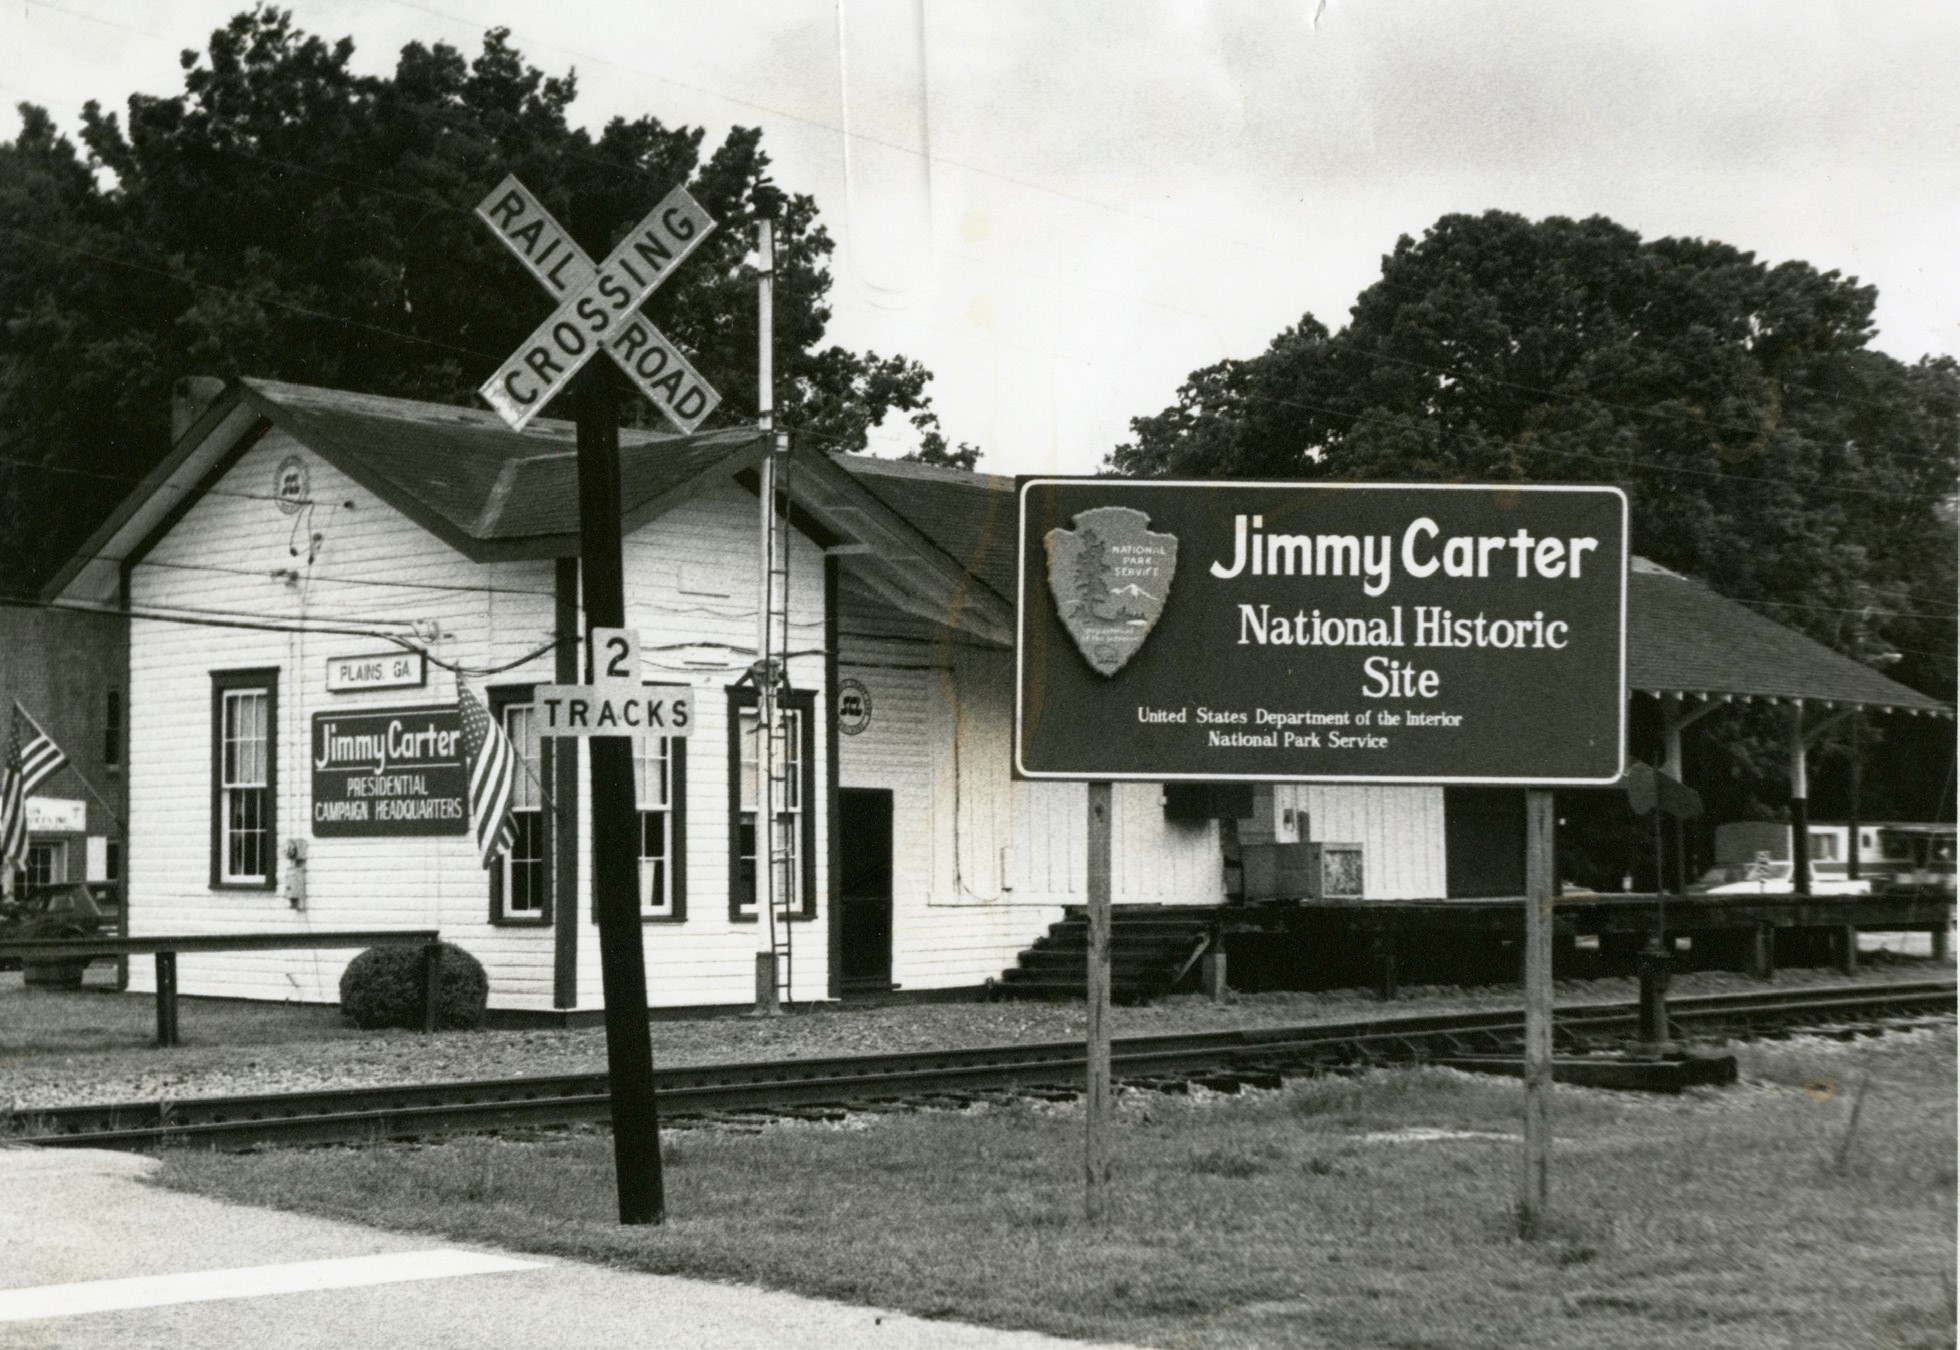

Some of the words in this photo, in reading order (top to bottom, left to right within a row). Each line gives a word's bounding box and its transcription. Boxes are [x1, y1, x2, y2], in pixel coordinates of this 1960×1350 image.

[489, 189, 574, 292] RAIL
[612, 321, 707, 420] ROAD
[504, 207, 695, 406] CROSSING
[1112, 545, 1166, 555] NATIONAL
[1123, 556, 1152, 565] PARK
[1209, 514, 1392, 597] Jimmy
[1401, 517, 1599, 579] Carter
[1114, 567, 1160, 577] SERVICE
[1237, 604, 1405, 647] National
[1413, 606, 1569, 649] Historic
[605, 636, 630, 678] 2
[1362, 655, 1440, 699] Site
[543, 698, 688, 728] TRACKS
[1137, 706, 1187, 724] United
[1196, 706, 1248, 724] States
[1255, 708, 1350, 729] Department
[1354, 709, 1372, 726] of
[1377, 709, 1401, 726] the
[1405, 709, 1463, 727] Interior
[315, 722, 386, 775] Jimmy
[387, 720, 461, 759] Carter
[1208, 730, 1278, 748] National
[1284, 731, 1321, 748] Park
[1328, 730, 1389, 749] Service
[346, 775, 429, 797] PRESIDENTIAL
[315, 801, 369, 822] CAMPAIGN
[374, 798, 463, 820] HEADQUARTERS
